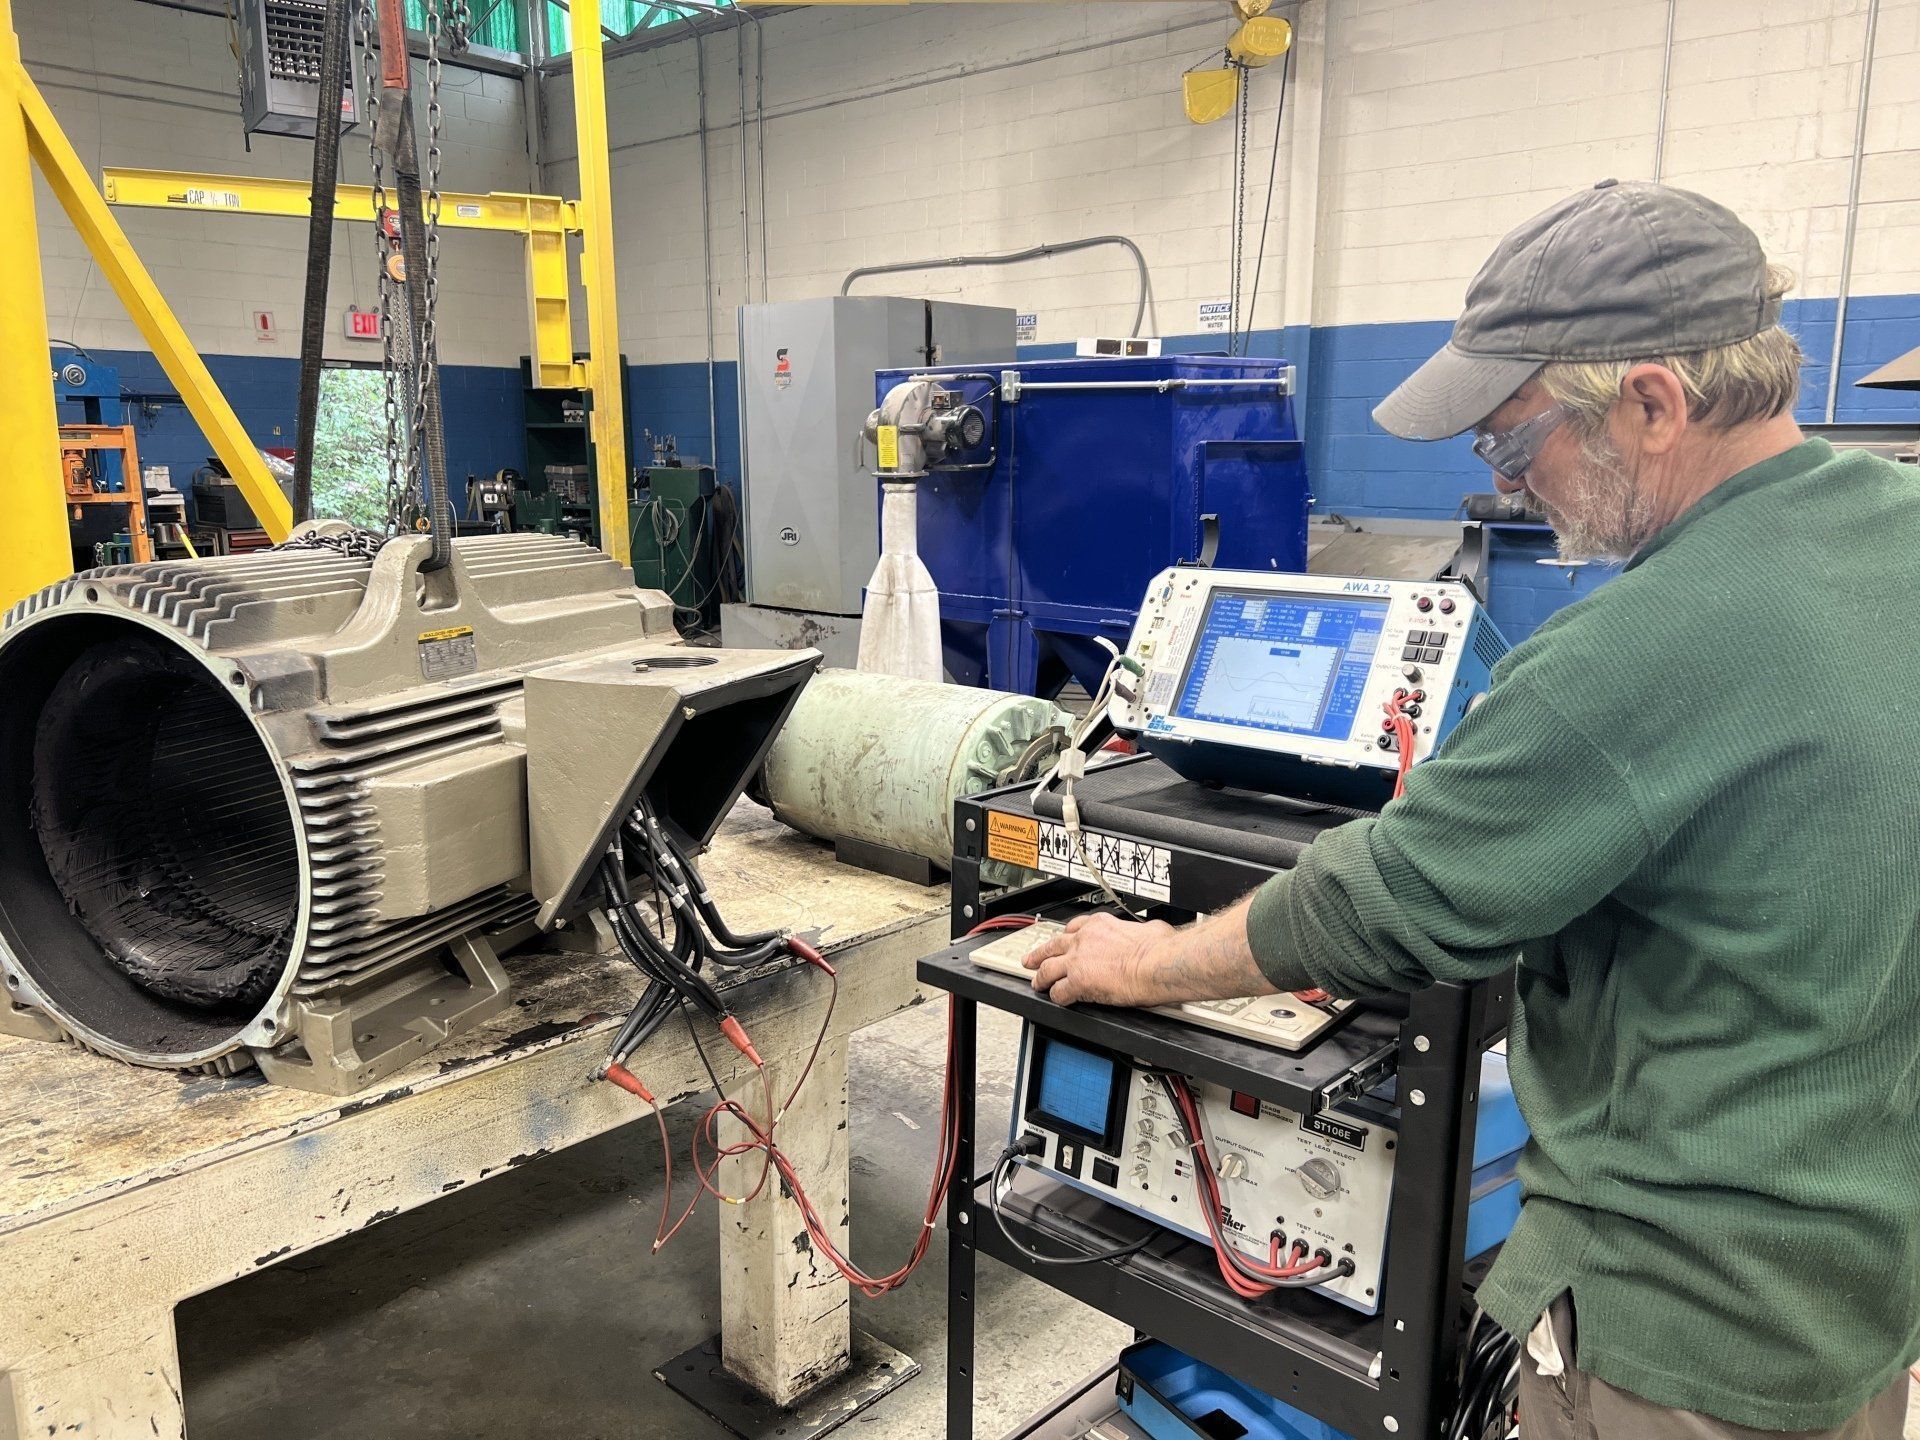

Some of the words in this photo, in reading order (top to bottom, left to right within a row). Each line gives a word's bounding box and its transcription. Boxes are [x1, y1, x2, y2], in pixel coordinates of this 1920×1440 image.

[188, 190, 204, 204] CAP
[224, 193, 240, 208] TON
[1202, 304, 1230, 314] NOTICE
[352, 314, 378, 334] EXIT
[1016, 315, 1036, 326] TICE
[782, 532, 796, 541] JRI
[1343, 582, 1370, 592] AWA
[1373, 584, 1390, 594] 2.2
[1000, 822, 1026, 834] WARNING
[1260, 1108, 1294, 1124] ENERGIZED
[1261, 1104, 1281, 1114] LEADS
[1314, 1120, 1352, 1140] ST106E
[1215, 1136, 1238, 1148] OUTPUT
[1238, 1144, 1265, 1158] CONTROL
[1297, 1136, 1312, 1146] TEST
[1314, 1143, 1331, 1153] LEAD
[1332, 1150, 1357, 1162] SELECT
[1245, 1178, 1258, 1187] MAX
[1220, 1212, 1246, 1232] aker
[1296, 1222, 1312, 1232] TEST
[1314, 1230, 1335, 1241] LEADS
